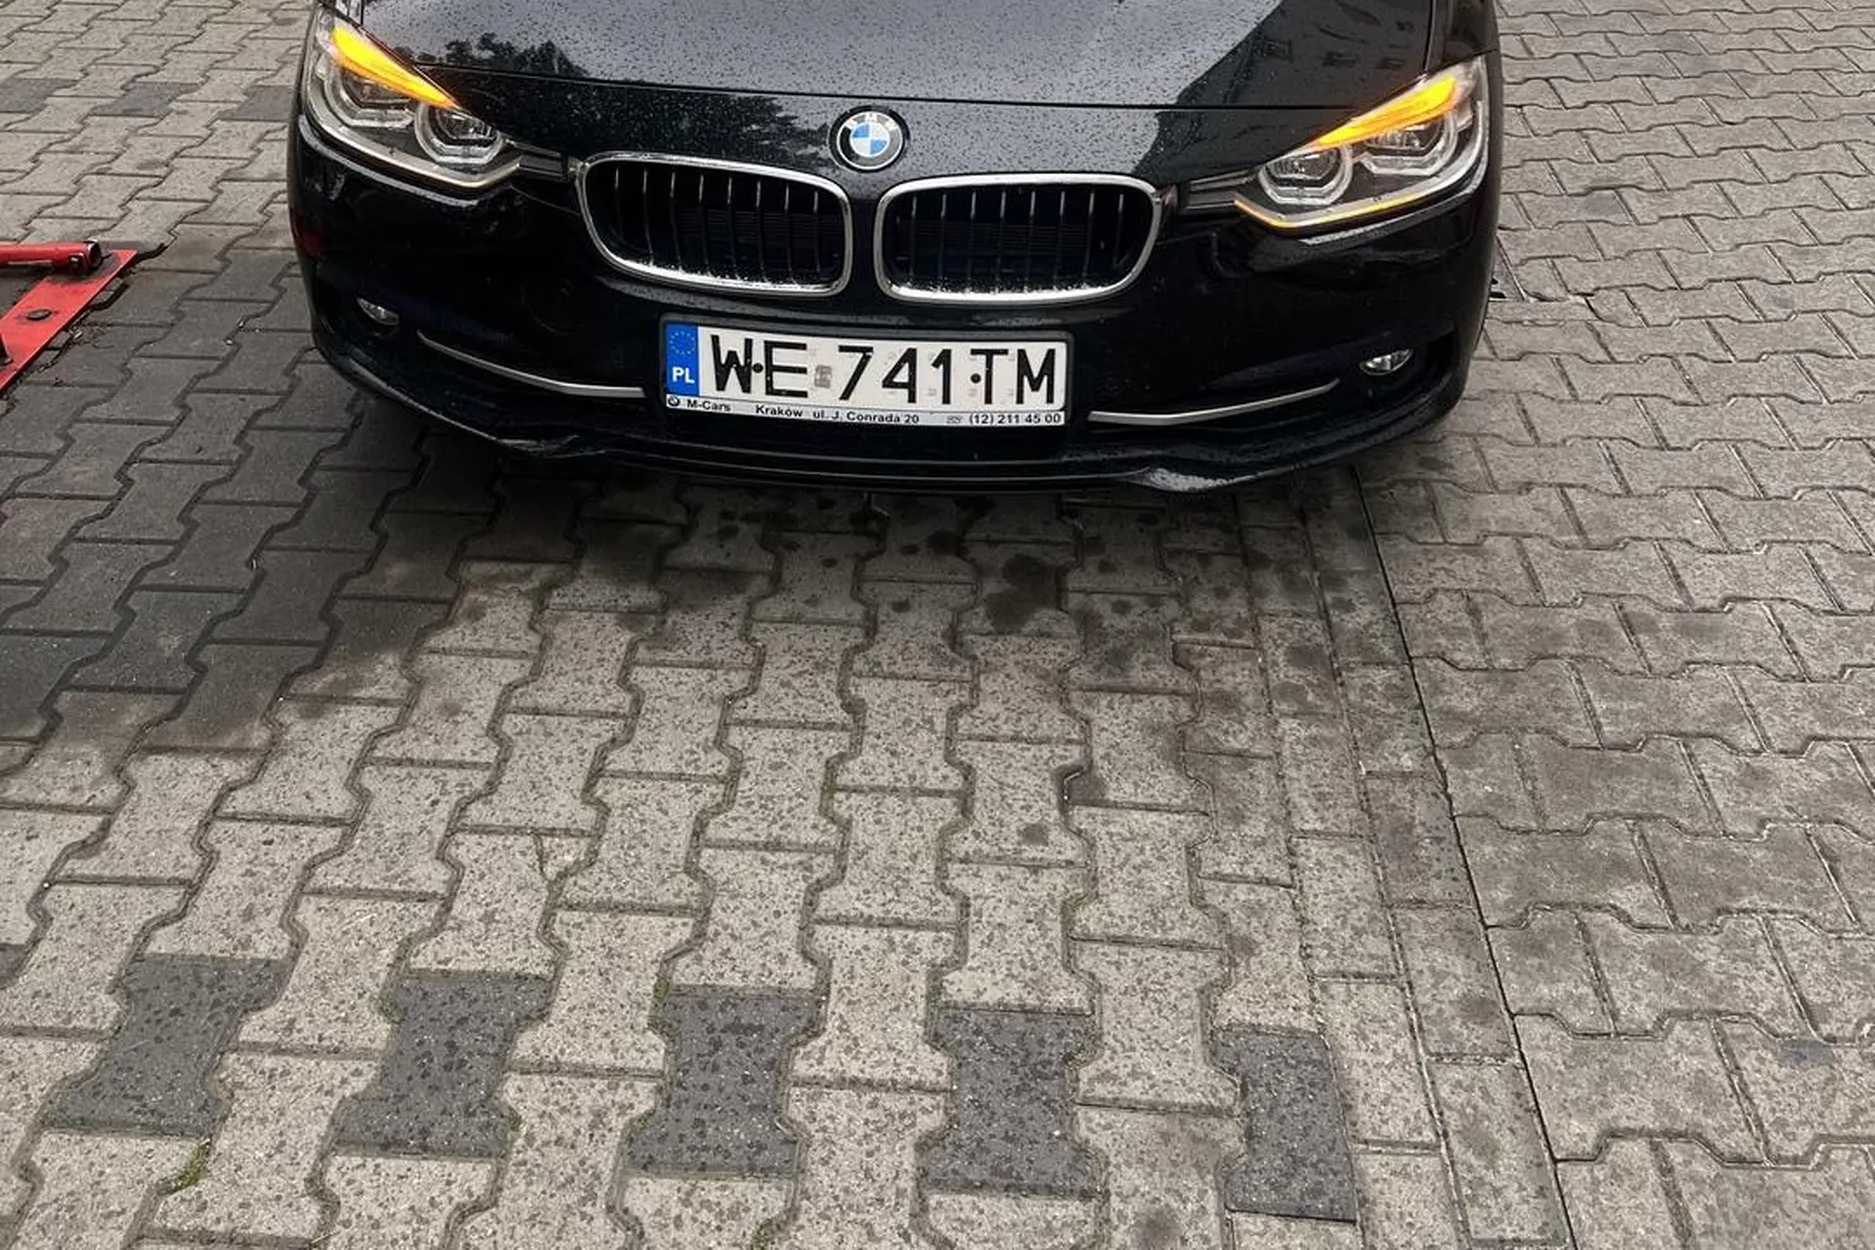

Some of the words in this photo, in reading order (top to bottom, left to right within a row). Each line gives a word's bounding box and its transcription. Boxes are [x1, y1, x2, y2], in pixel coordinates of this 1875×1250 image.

[672, 366, 695, 384] PL
[710, 334, 809, 399] WE
[686, 399, 731, 412] M-Cars
[755, 404, 803, 418] Kraków
[846, 411, 901, 424] Conrada
[904, 414, 920, 424] 20
[969, 413, 994, 425] (12)
[997, 413, 1020, 424] 211
[1025, 413, 1041, 424] 45
[1044, 413, 1061, 424] 00
